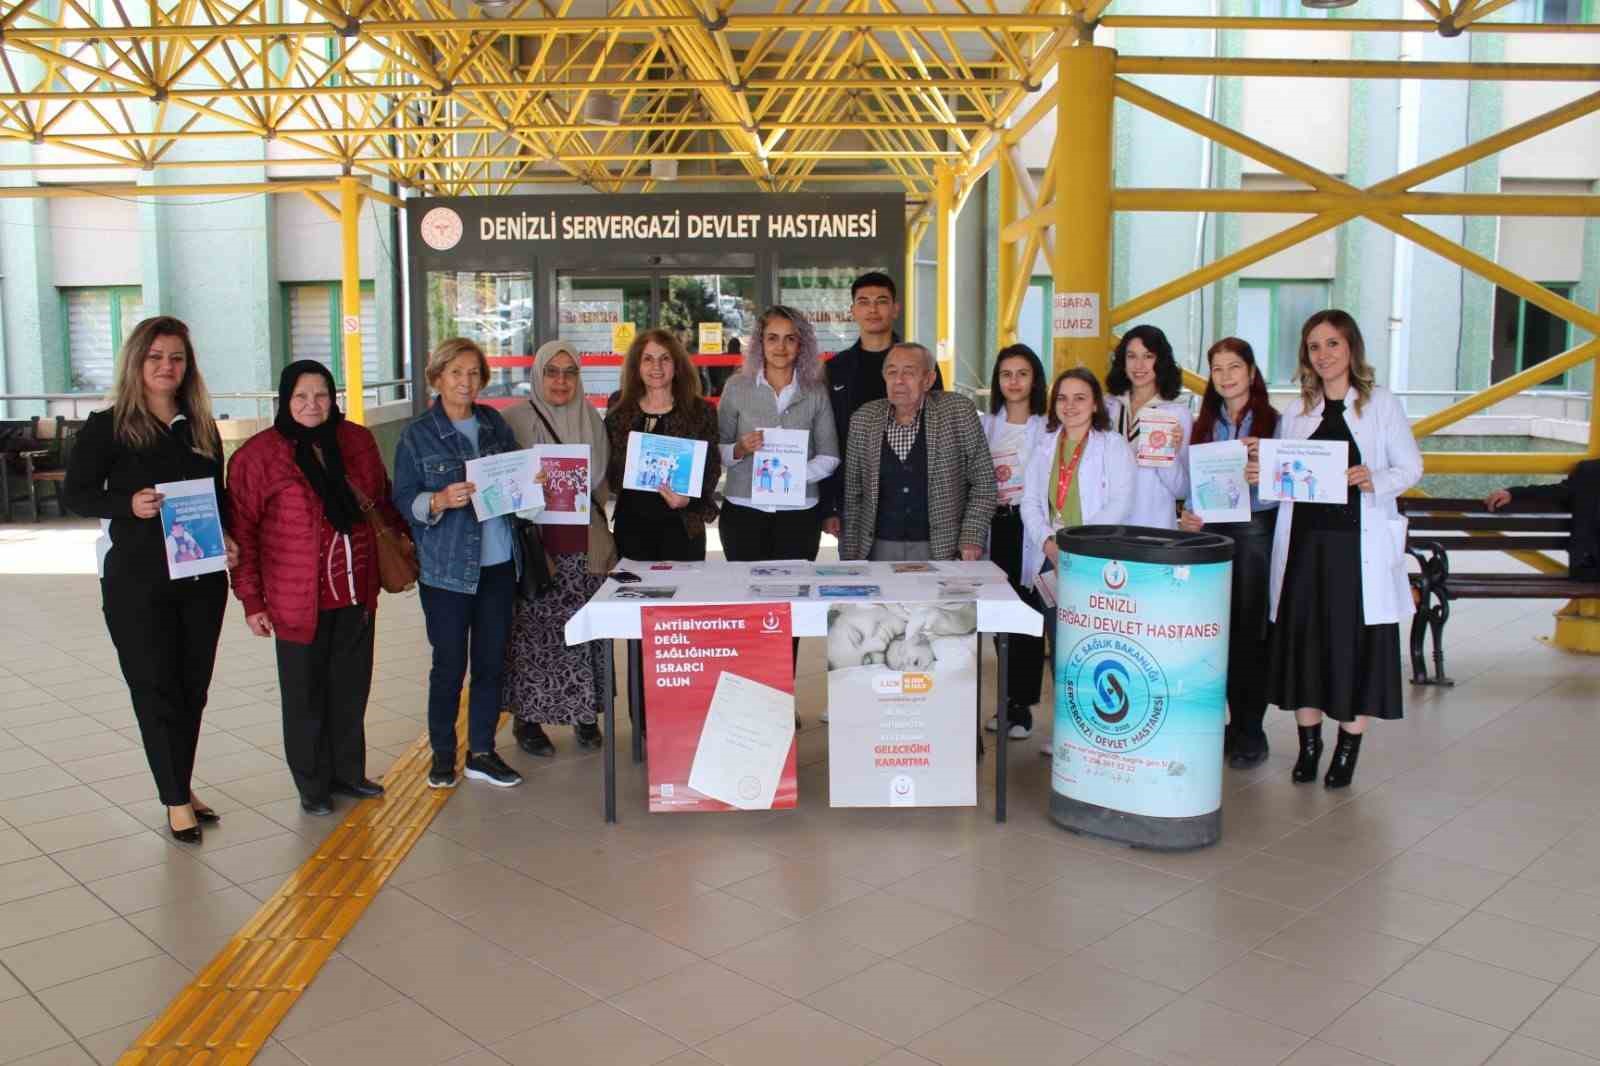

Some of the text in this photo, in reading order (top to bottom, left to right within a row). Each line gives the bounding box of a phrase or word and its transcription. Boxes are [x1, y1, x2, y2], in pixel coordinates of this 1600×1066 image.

[480, 211, 556, 241] DENİZLİ
[562, 210, 680, 240] SERVERGAZİ
[687, 214, 761, 239] DEVLET
[767, 209, 877, 238] HASTANESİ
[654, 617, 746, 631] ANTİBİYOTİKTE
[1093, 616, 1144, 636] DEVLET
[654, 632, 690, 645] DEĞİL
[655, 646, 739, 659] SAĞLIĞINIZDA
[1081, 638, 1113, 657] SAĞLIK
[1114, 639, 1160, 683] BAKANLIĞI
[656, 662, 704, 673] ISRARCI
[656, 676, 690, 687] OLUN
[874, 743, 930, 754] GELECEĞİNİ
[1095, 735, 1128, 749] DEVLET
[874, 757, 929, 769] KARARTMA
